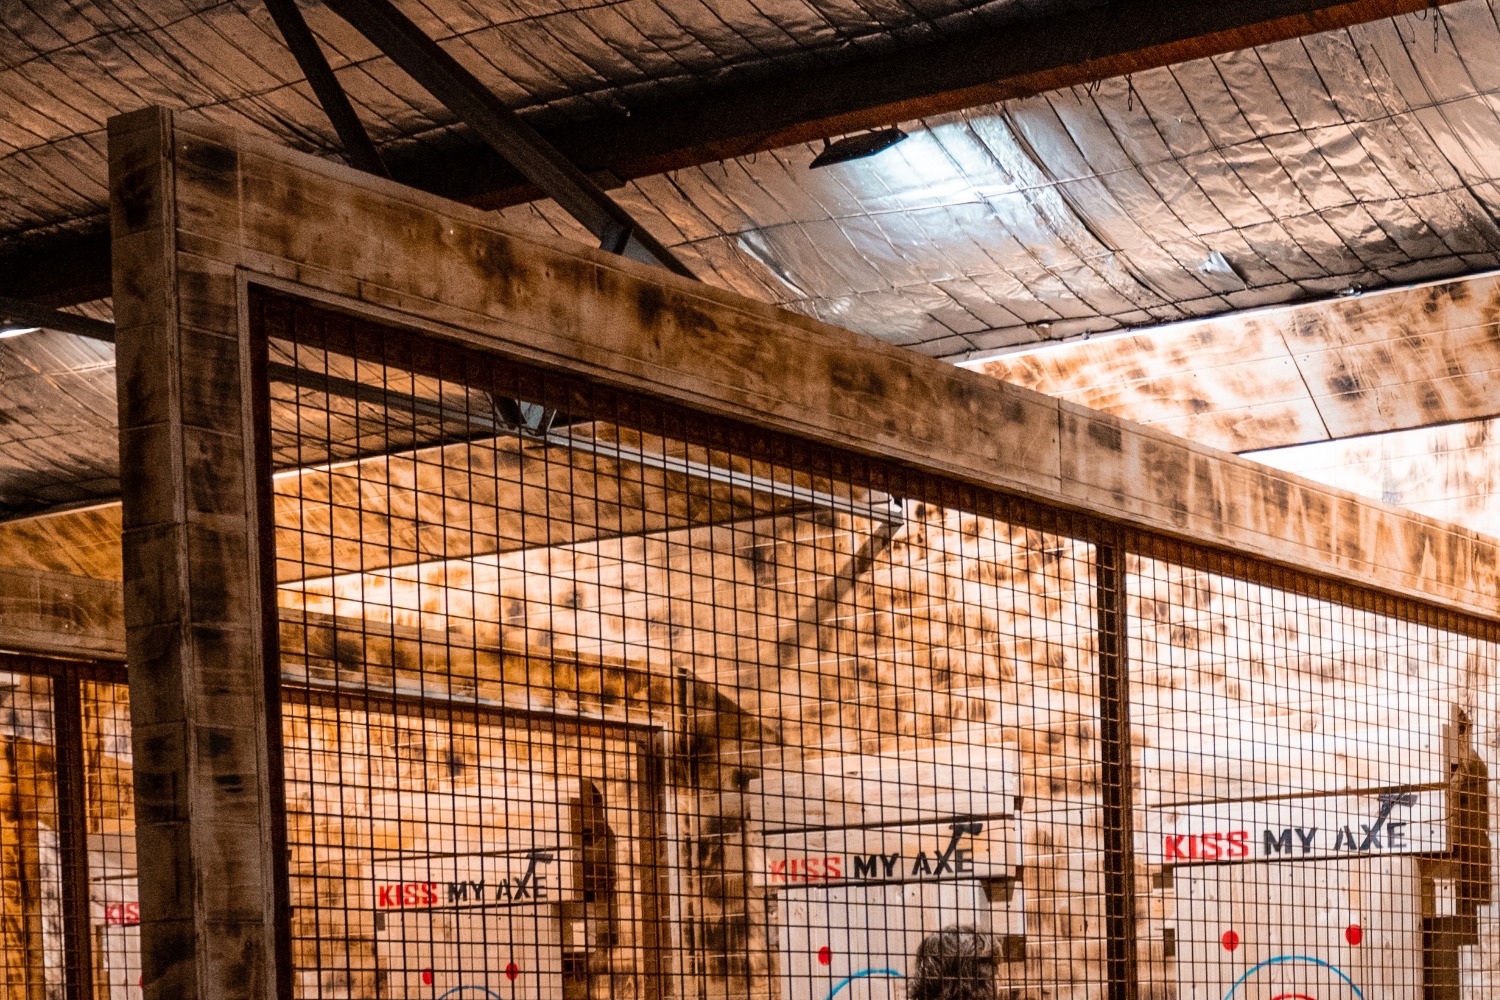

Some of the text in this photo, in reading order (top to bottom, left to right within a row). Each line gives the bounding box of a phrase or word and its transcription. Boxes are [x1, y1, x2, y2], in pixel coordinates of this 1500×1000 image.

[770, 823, 983, 883] KISS MY AXE
[1165, 793, 1418, 861] KISS MY AXE
[379, 853, 553, 907] KISS MY AXE
[106, 902, 139, 924] KIS
